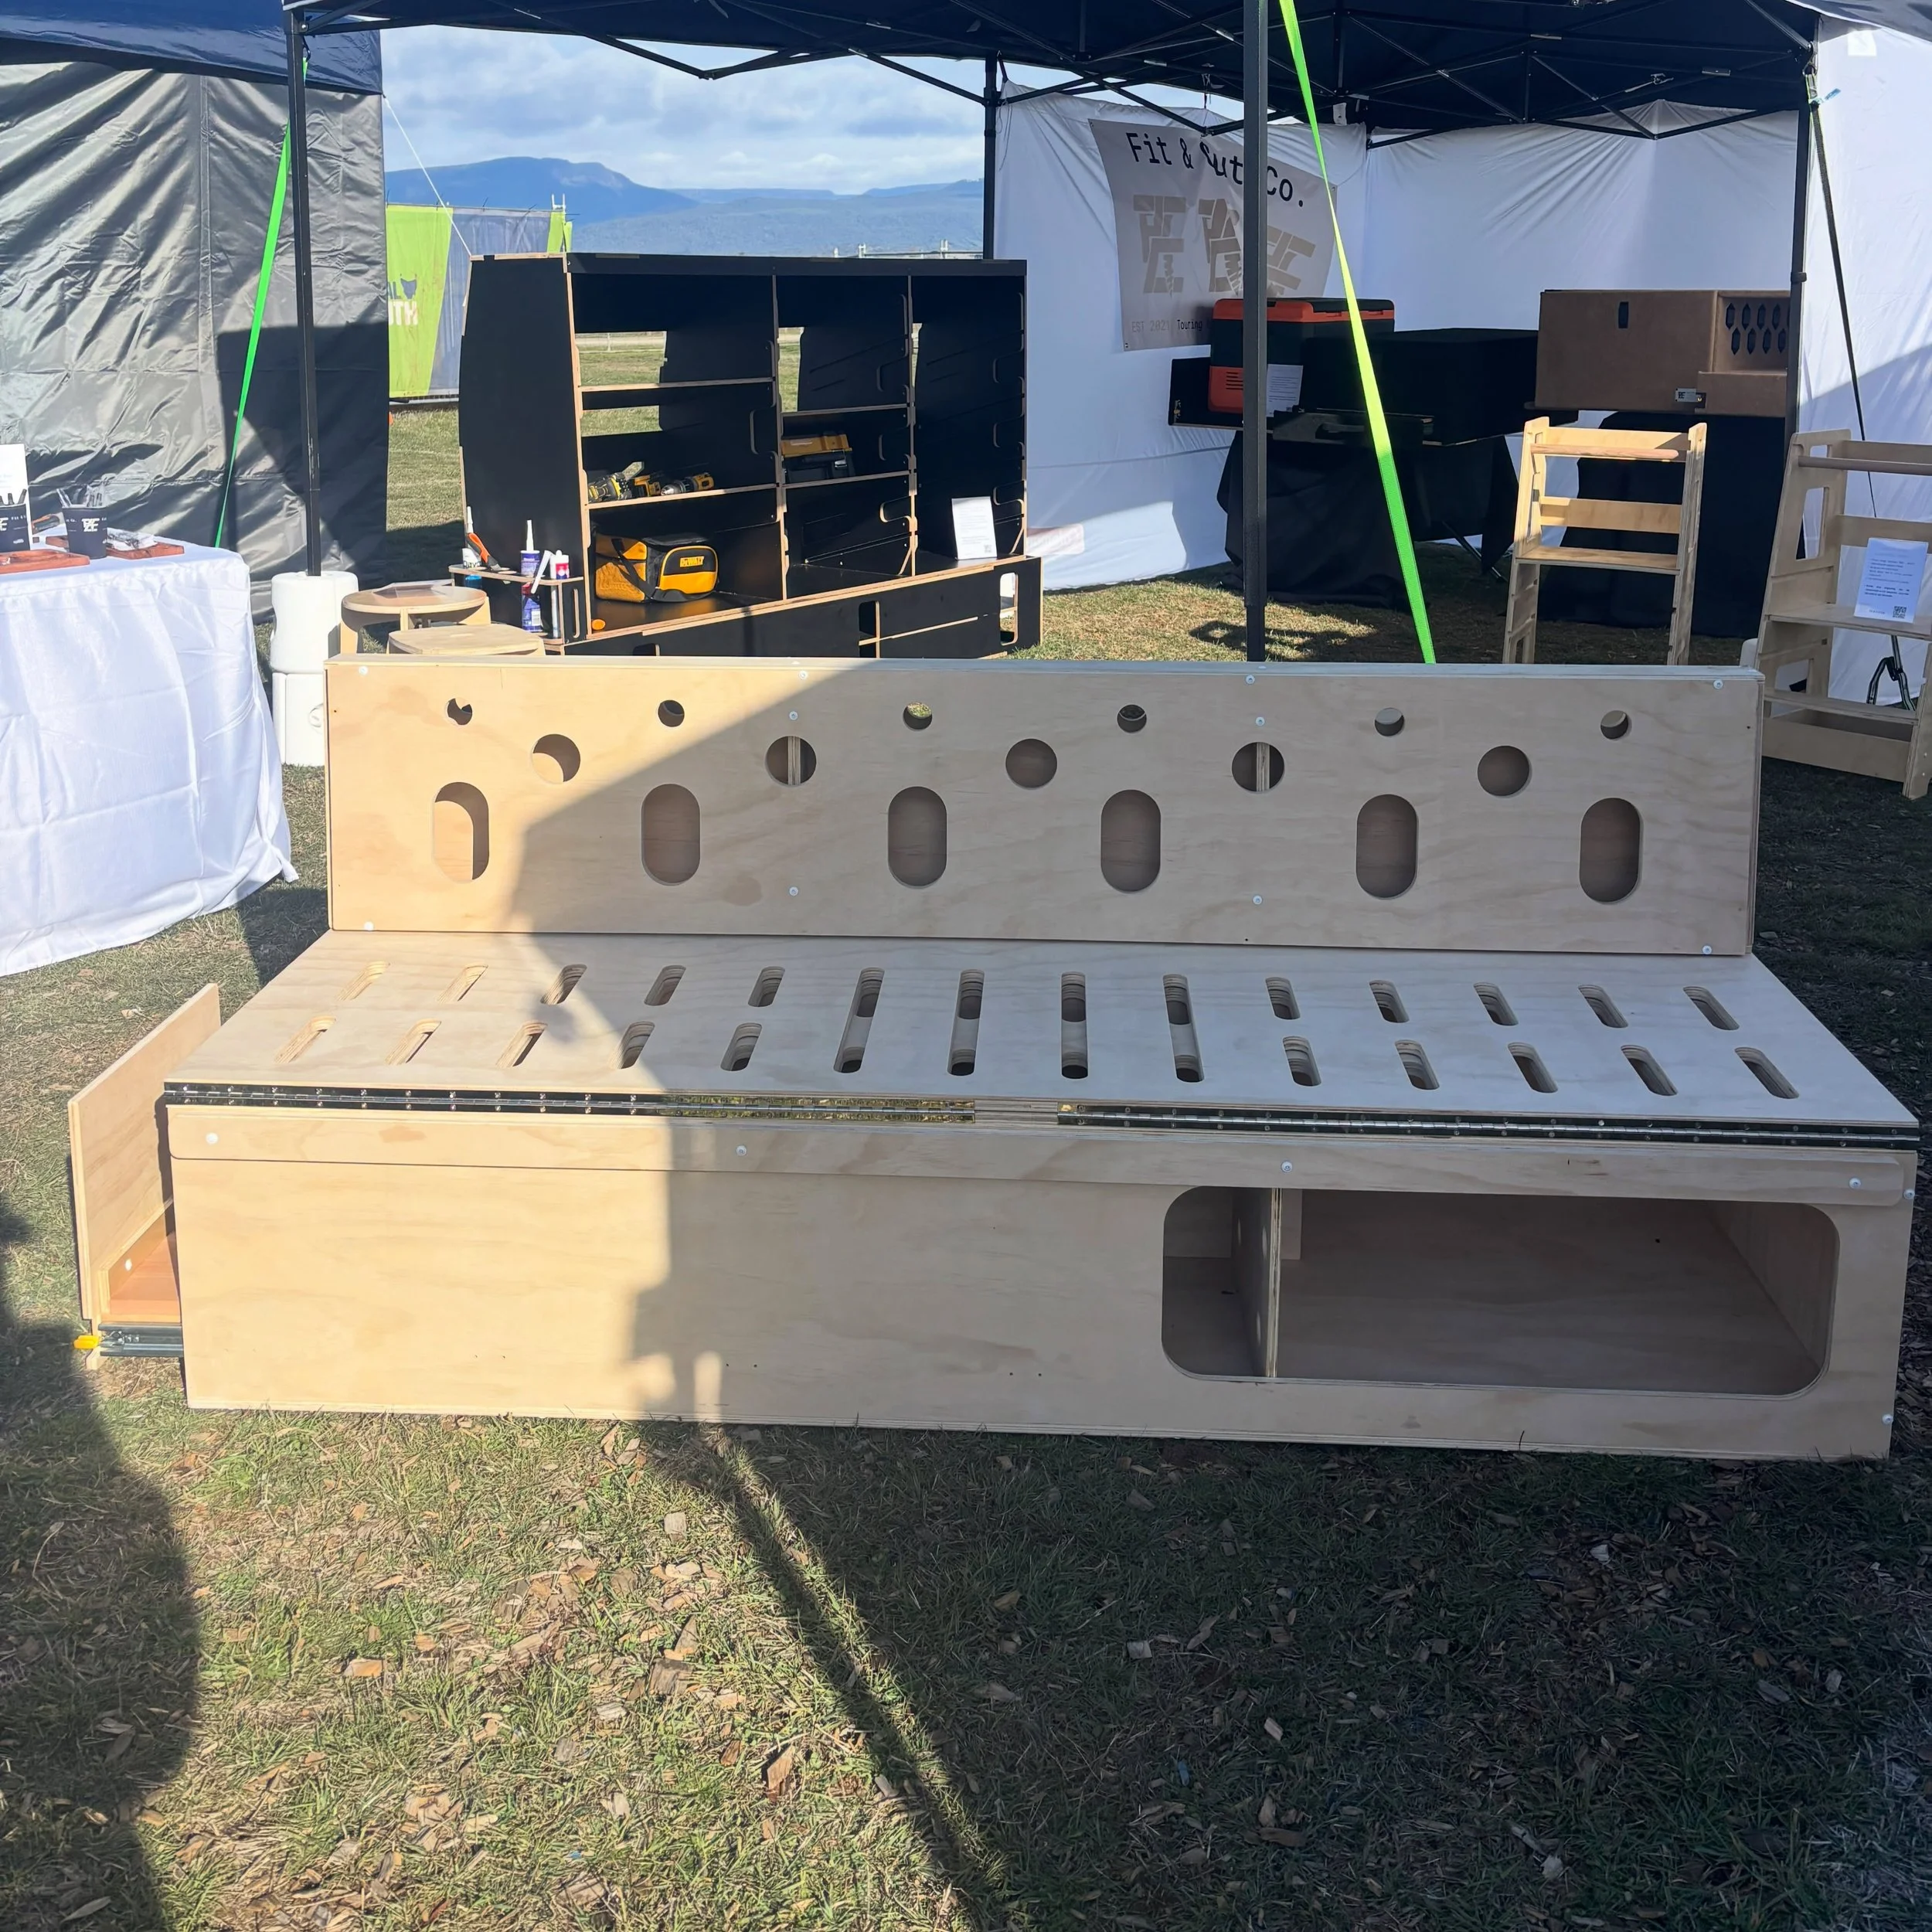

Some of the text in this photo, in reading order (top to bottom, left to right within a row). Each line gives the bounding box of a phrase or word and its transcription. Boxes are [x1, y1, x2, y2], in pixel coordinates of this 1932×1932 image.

[1126, 132, 1172, 165] Fit
[1179, 138, 1195, 169] &
[1267, 165, 1304, 208] Co.
[1131, 321, 1145, 332] EST
[1177, 319, 1203, 332] Touring
